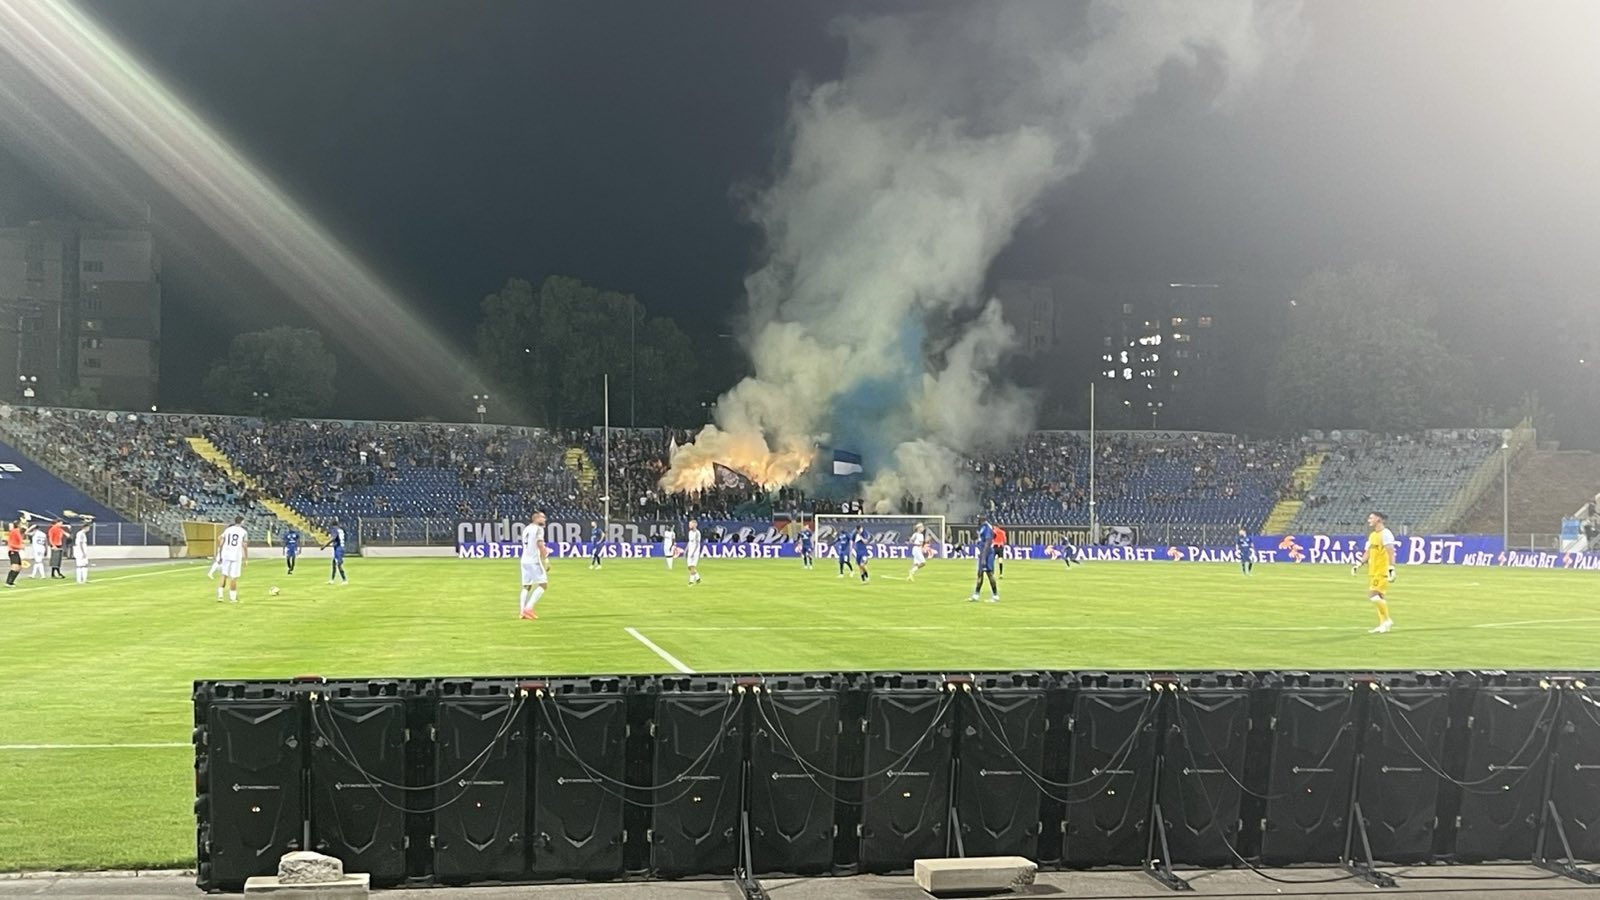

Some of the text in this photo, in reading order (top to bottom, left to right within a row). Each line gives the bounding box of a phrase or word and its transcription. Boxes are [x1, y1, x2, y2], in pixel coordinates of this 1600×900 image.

[227, 533, 239, 547] 18
[489, 542, 523, 558] BET
[620, 542, 654, 558] BET
[700, 543, 782, 558] ALMS BET
[877, 543, 909, 558] BET
[1003, 544, 1033, 560] BET
[1124, 546, 1156, 561] BET
[1406, 536, 1463, 565] BET
[1478, 550, 1494, 566] BET
[1507, 550, 1558, 568] PALMS BET
